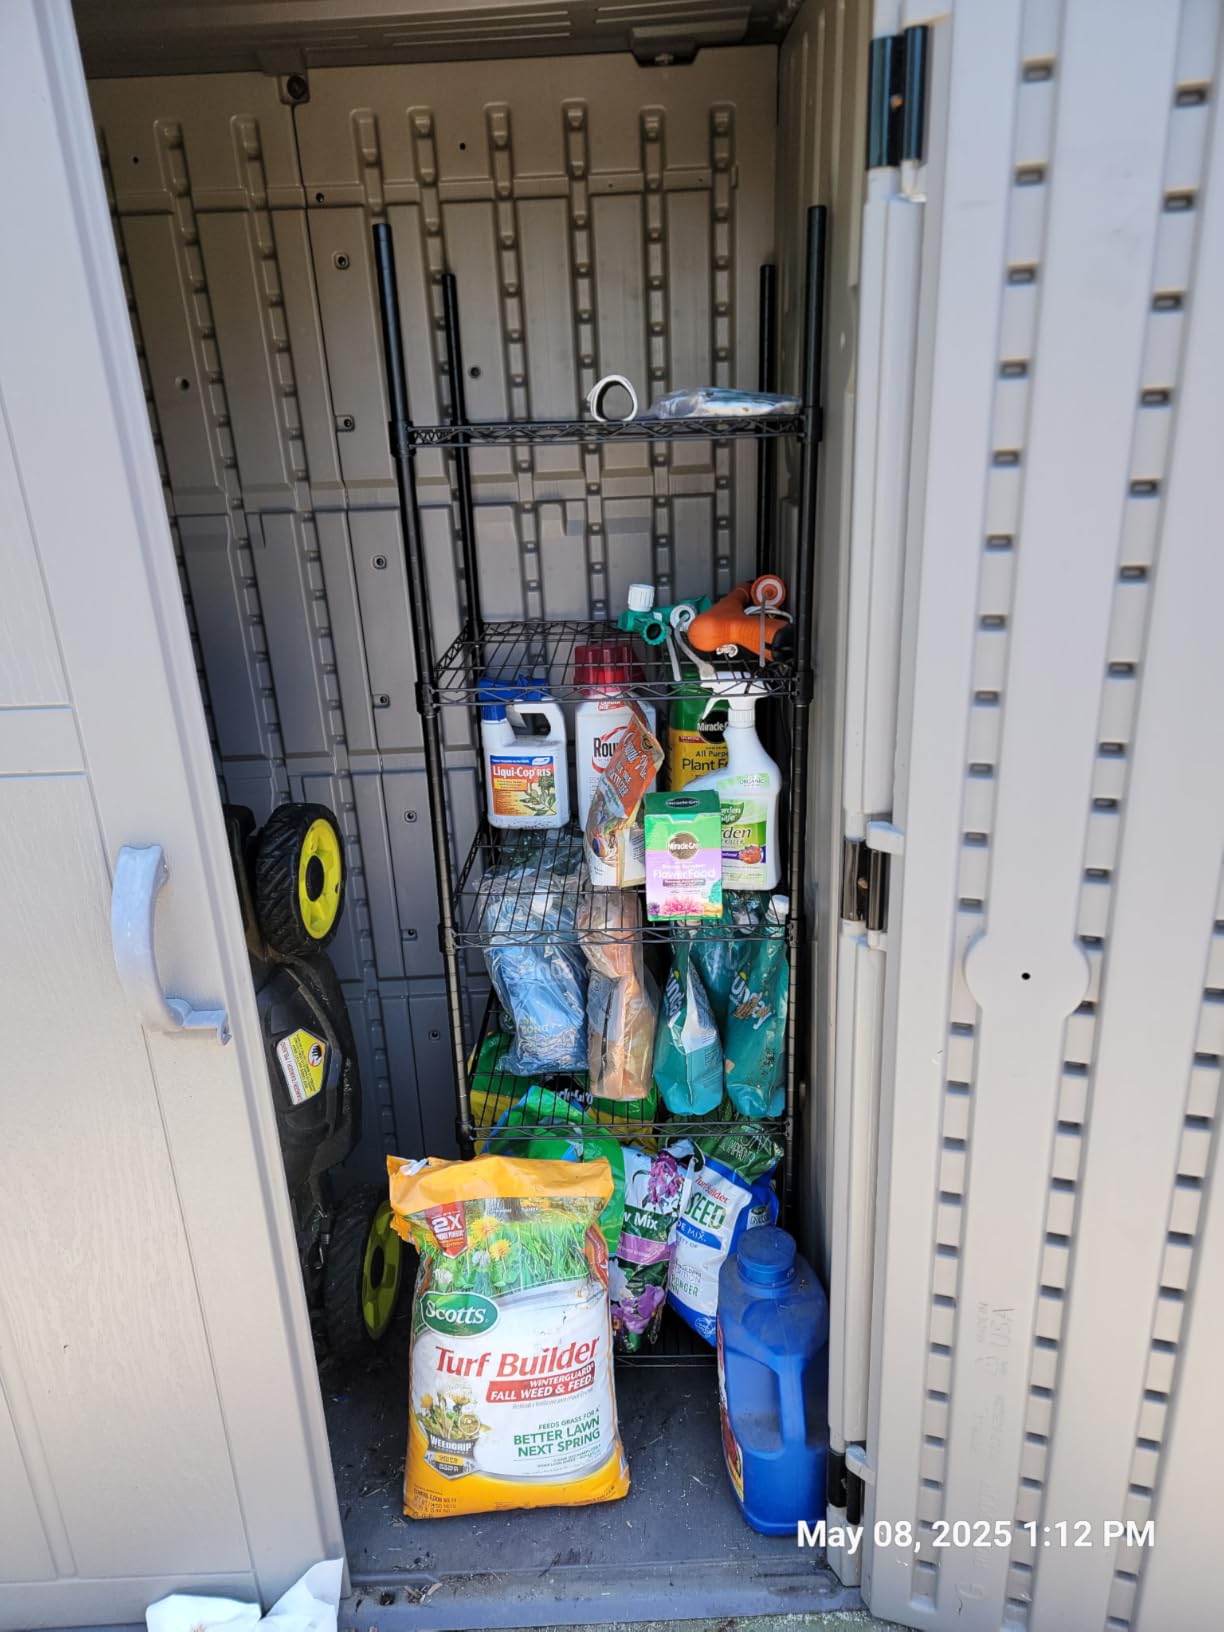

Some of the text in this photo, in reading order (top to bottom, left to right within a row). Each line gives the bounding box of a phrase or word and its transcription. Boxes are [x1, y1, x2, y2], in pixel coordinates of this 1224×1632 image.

[682, 757, 715, 771] Plant
[431, 1213, 463, 1234] 2X
[634, 1212, 658, 1231] Mix
[684, 1192, 726, 1230] SEED
[425, 1300, 487, 1325] Scotts
[435, 1337, 600, 1378] Turf Builder
[490, 1391, 517, 1401] FALL
[520, 1386, 553, 1399] WEED
[555, 1384, 565, 1394] &
[567, 1374, 592, 1392] FEED
[529, 1364, 594, 1388] WINTERGUARD
[513, 1415, 600, 1446] BETTER LAWN
[538, 1422, 560, 1430] FEEDS
[561, 1415, 582, 1426] GRASS
[583, 1409, 595, 1419] FOR
[518, 1428, 600, 1457] NEXT SPRING
